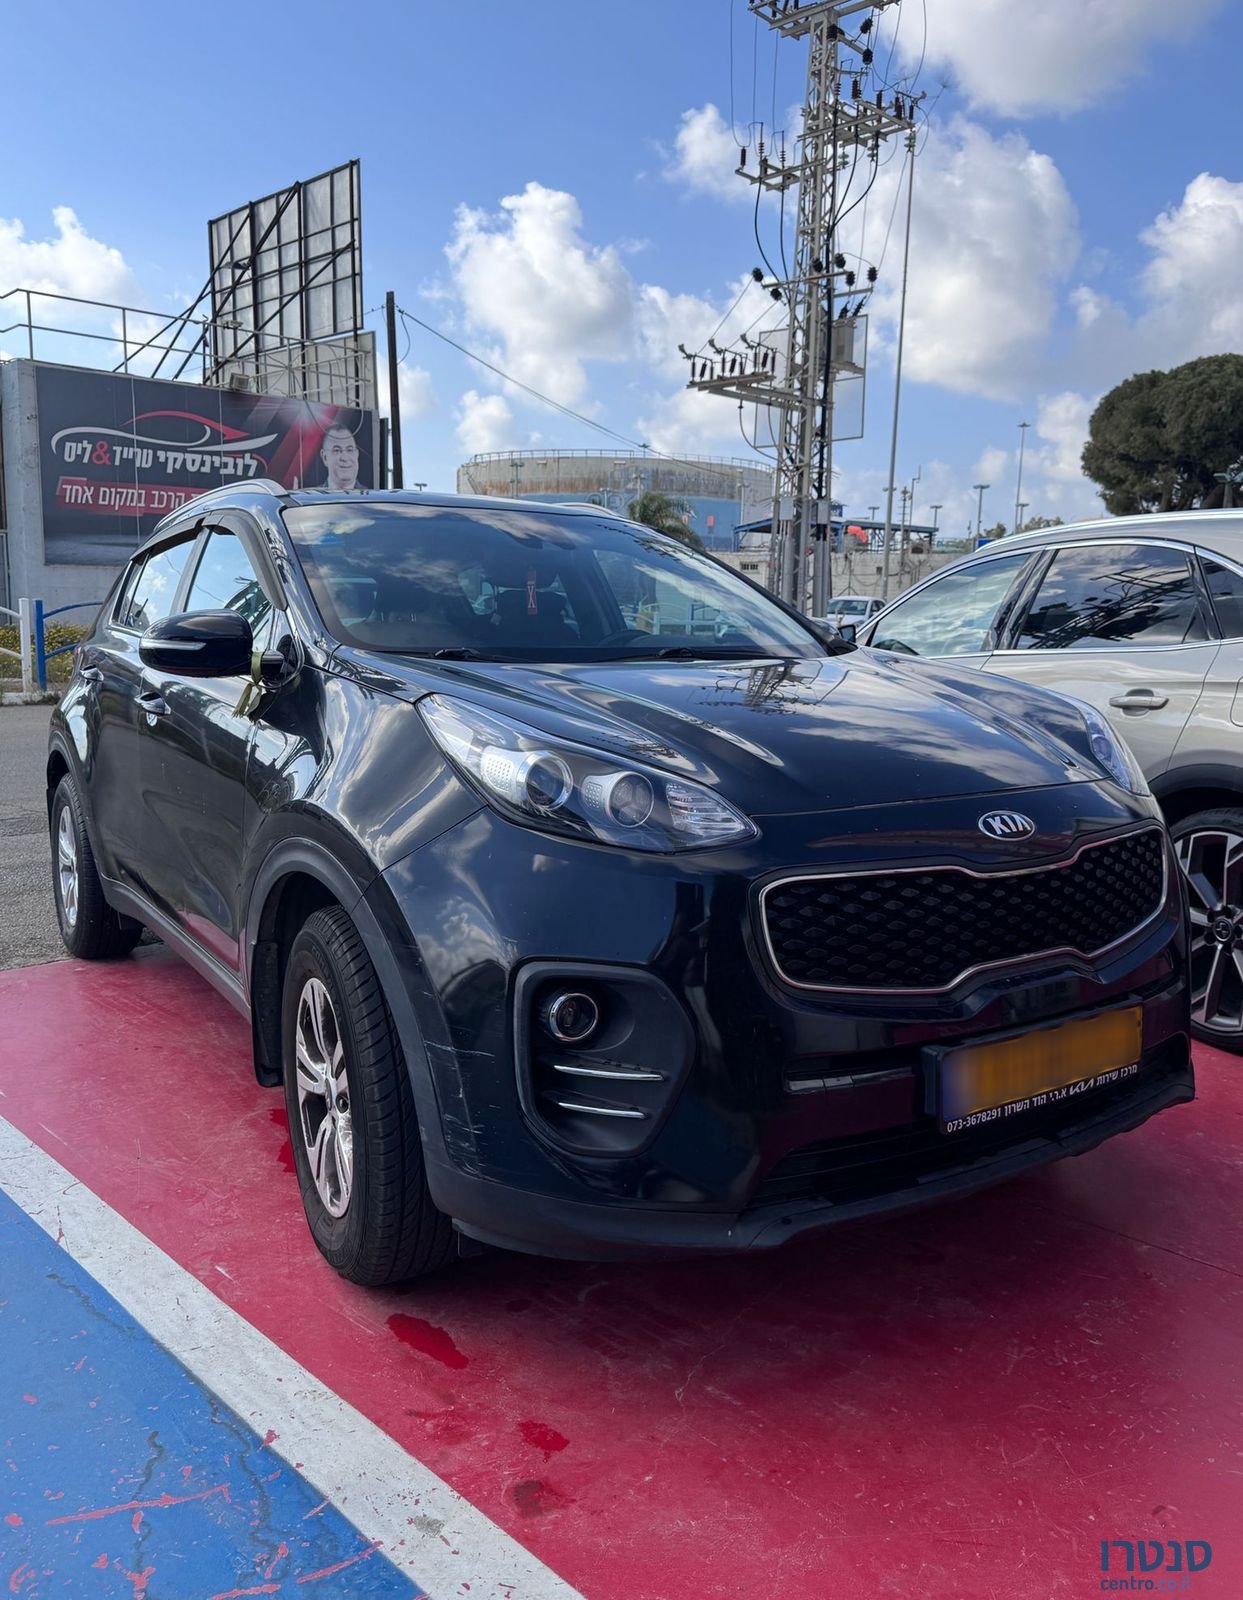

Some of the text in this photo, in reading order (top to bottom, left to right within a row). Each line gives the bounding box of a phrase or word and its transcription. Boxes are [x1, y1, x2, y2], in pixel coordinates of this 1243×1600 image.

[157, 451, 258, 476] לובינסקי
[62, 484, 186, 511] הרכב במקום אחד
[986, 814, 1031, 835] KIA
[1096, 1070, 1119, 1086] שירות
[1120, 1064, 1138, 1078] מרכז
[1004, 1099, 1030, 1117] השרון
[1032, 1094, 1047, 1107] הוד
[947, 1107, 1001, 1133] 073-3678291
